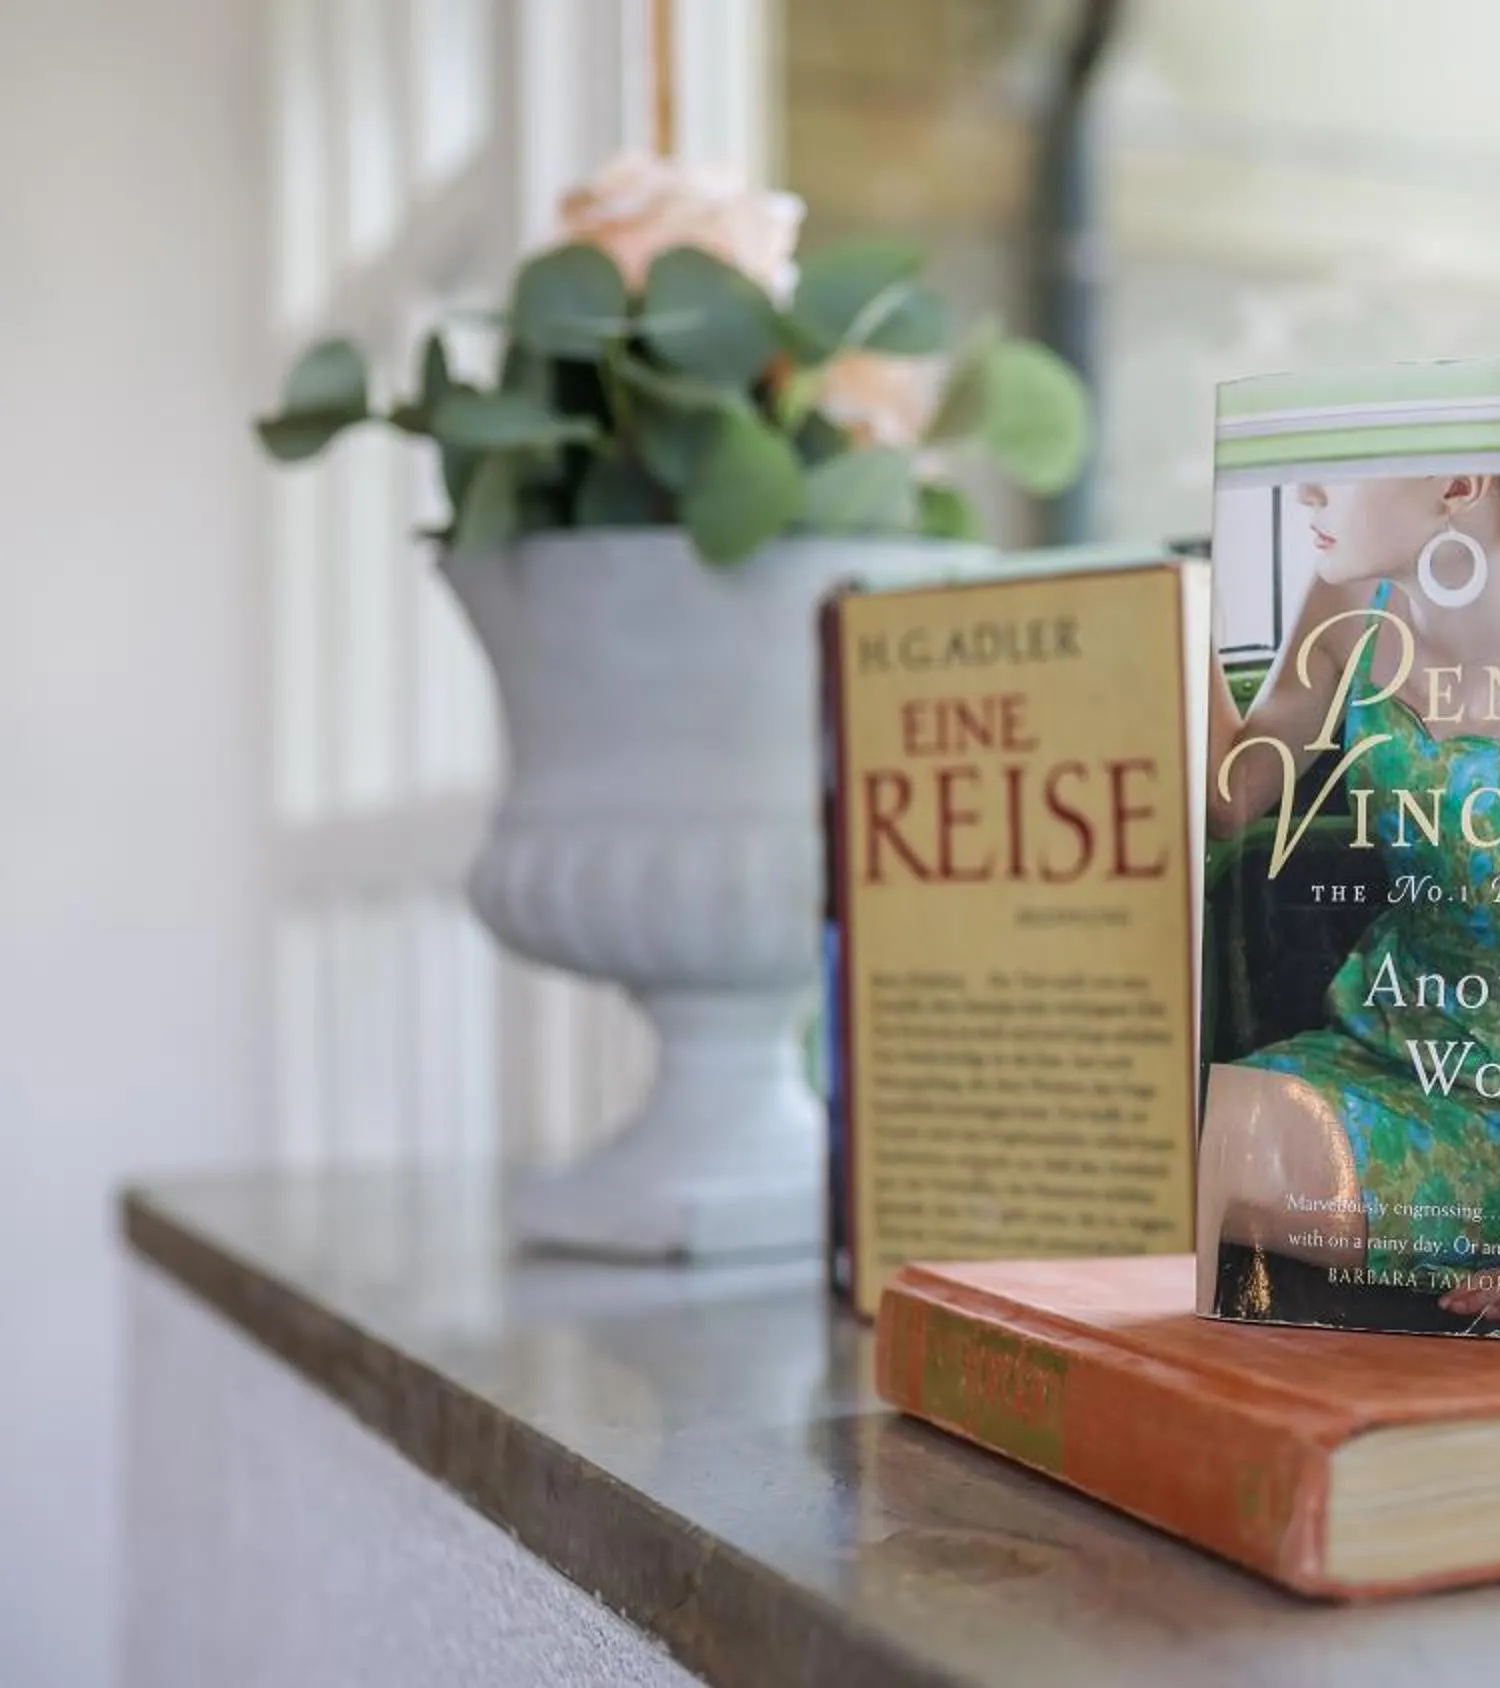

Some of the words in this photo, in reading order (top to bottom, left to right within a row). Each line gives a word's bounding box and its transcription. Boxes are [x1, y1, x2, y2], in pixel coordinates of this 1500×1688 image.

[903, 692, 1039, 758] EINE
[862, 758, 1168, 886] REISE
[1311, 885, 1367, 902] THE
[1288, 1229, 1324, 1248] with
[1327, 1236, 1349, 1249] on
[1353, 1236, 1362, 1249] a
[1367, 1234, 1407, 1254] rainy
[1413, 1234, 1449, 1255] day.
[1453, 1235, 1477, 1254] Or
[1327, 1267, 1417, 1287] BARBARA
